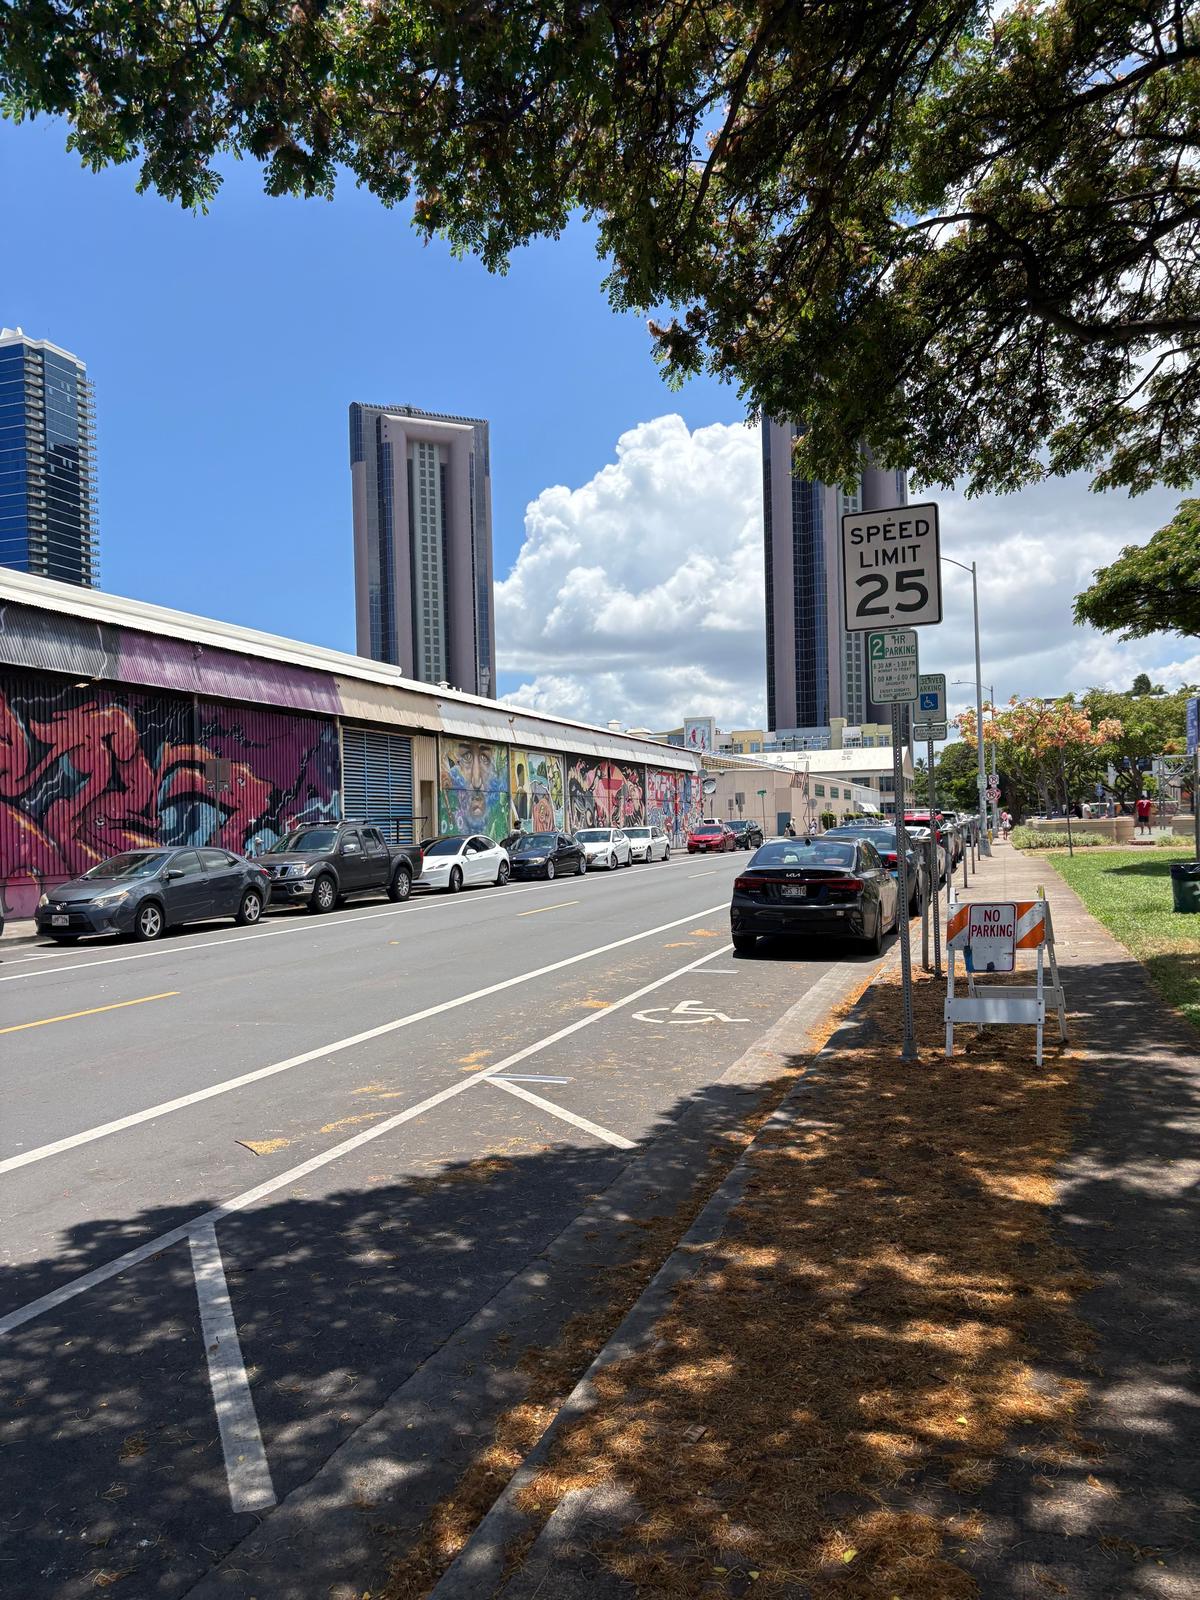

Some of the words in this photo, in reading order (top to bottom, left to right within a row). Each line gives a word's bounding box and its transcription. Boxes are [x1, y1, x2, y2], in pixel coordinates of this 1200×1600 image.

[850, 519, 930, 545] SPEED
[859, 544, 921, 569] LIMIT
[855, 568, 929, 617] 25
[872, 638, 883, 656] 2
[893, 634, 906, 645] HR
[885, 645, 916, 657] PARKING
[920, 685, 942, 693] ARKING
[984, 909, 1001, 923] NO
[971, 924, 1013, 938] PARKING
